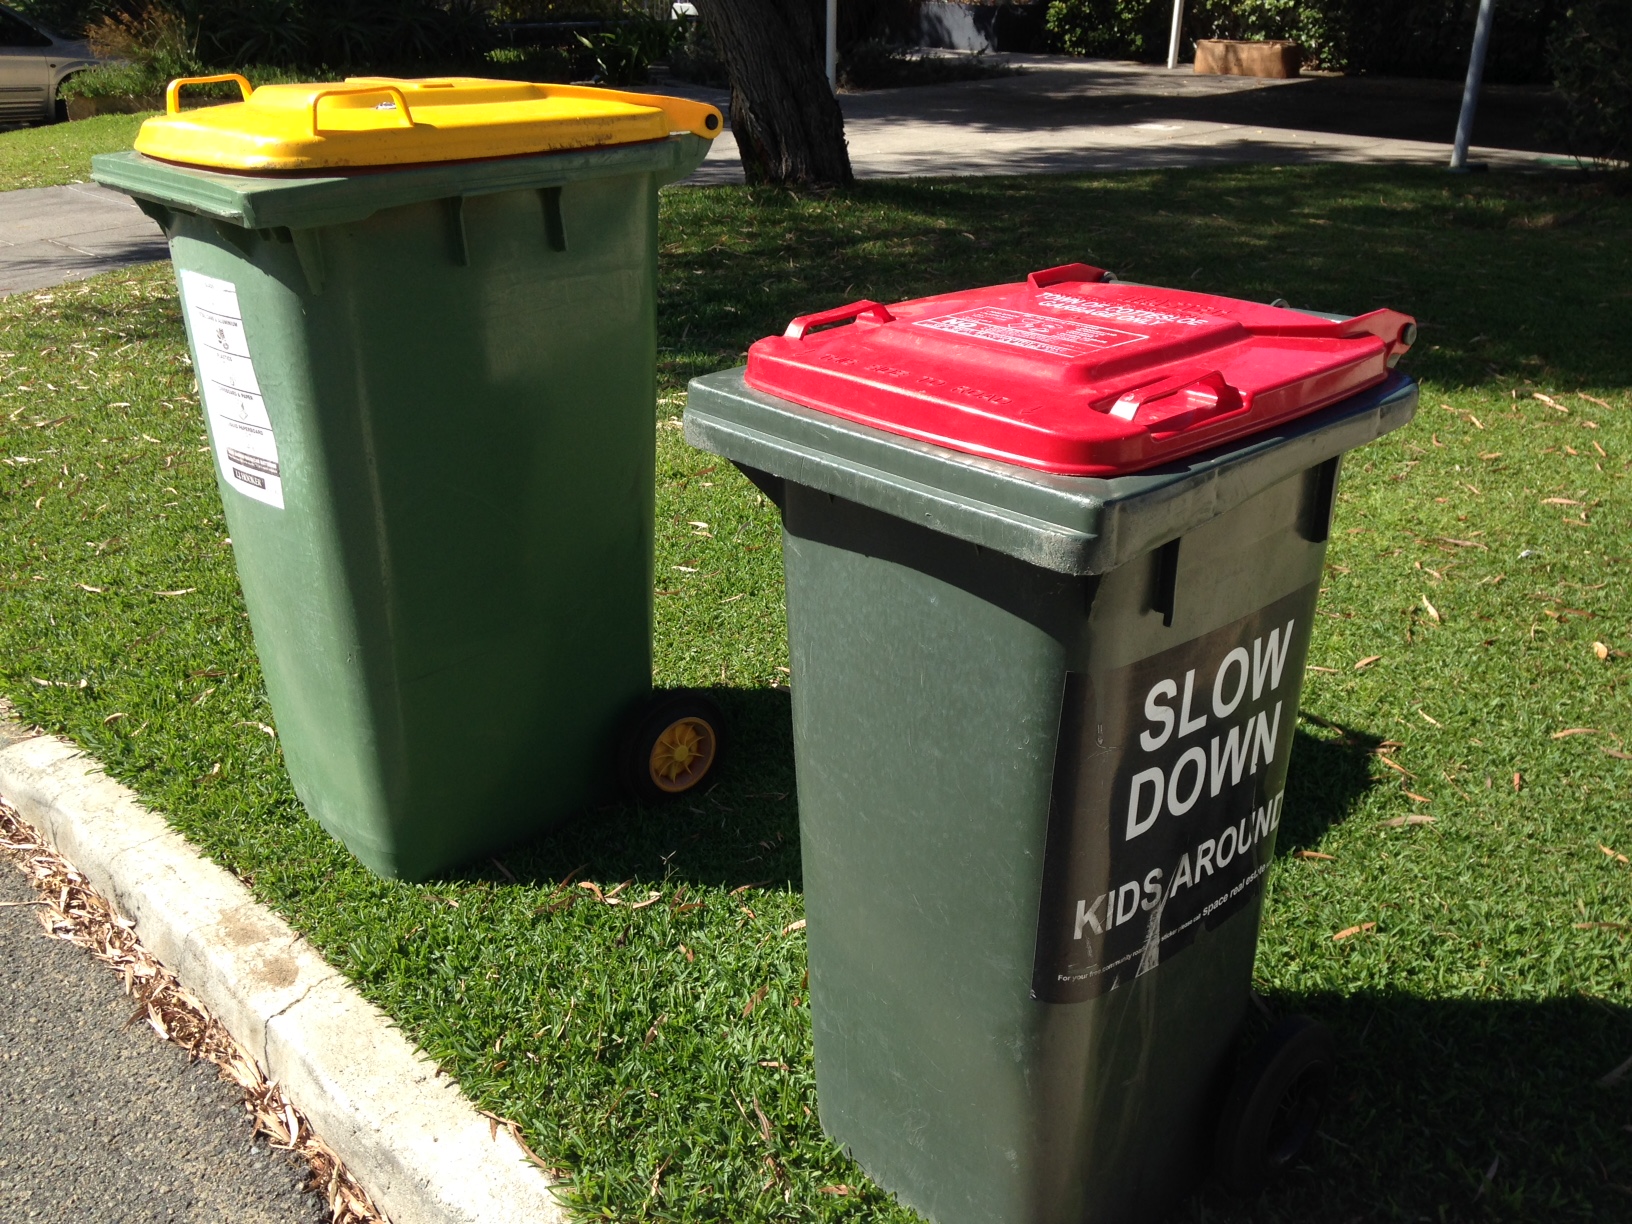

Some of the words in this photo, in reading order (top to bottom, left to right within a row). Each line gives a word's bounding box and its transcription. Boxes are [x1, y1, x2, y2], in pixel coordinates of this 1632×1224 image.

[1035, 292, 1081, 307] TOWN
[1081, 299, 1110, 311] OF
[1105, 304, 1209, 326] COTTESLOE
[1038, 300, 1121, 319] GARBAGE
[1117, 314, 1166, 326] ONLY
[950, 384, 1013, 406] ROAD
[1140, 619, 1295, 752] SLOW
[1125, 700, 1282, 842] DOWN
[1073, 867, 1164, 940] KIDS
[1169, 789, 1284, 899] AROUND
[1057, 974, 1071, 982] For
[1072, 973, 1088, 983] your
[1101, 953, 1133, 973] community
[1202, 893, 1229, 917] space
[1229, 878, 1246, 899] real
